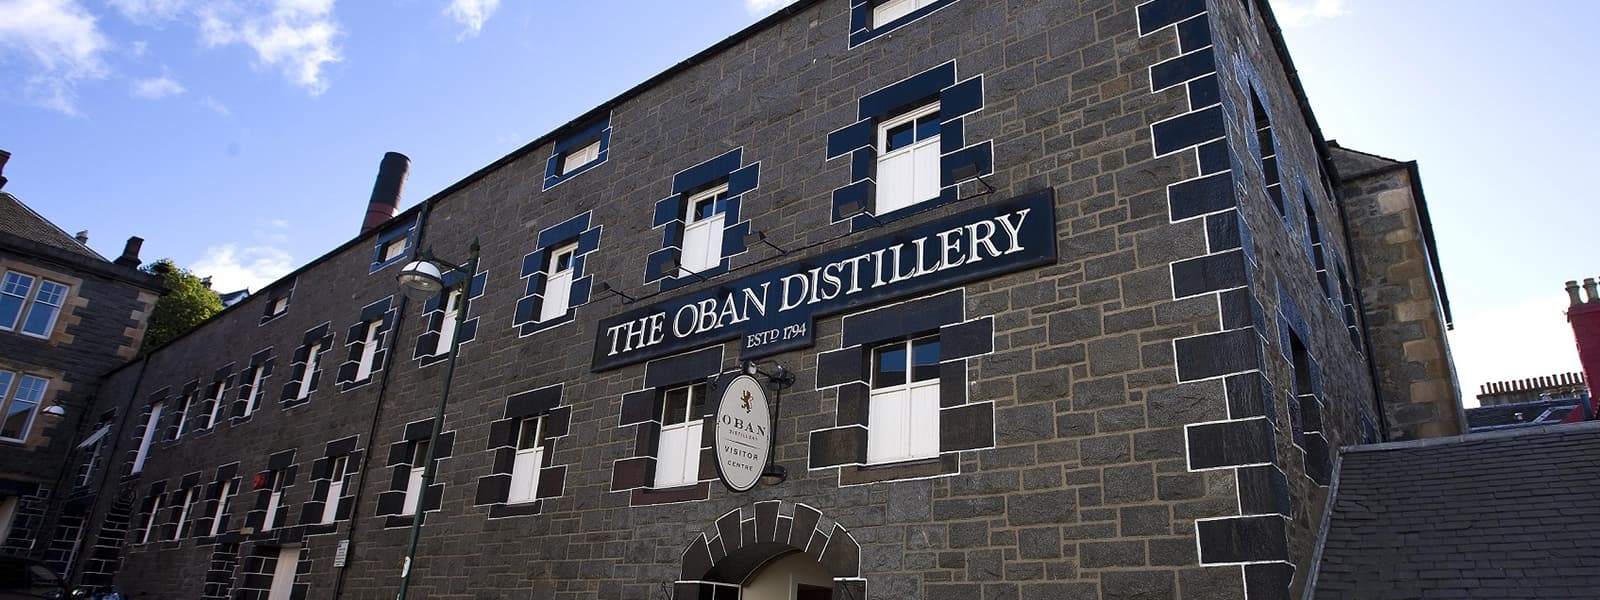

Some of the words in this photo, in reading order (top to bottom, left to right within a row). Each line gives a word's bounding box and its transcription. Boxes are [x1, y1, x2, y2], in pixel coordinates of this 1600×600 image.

[606, 311, 666, 357] THE
[672, 281, 771, 335] OBAN
[778, 208, 1031, 313] DISTILLERY
[782, 323, 807, 342] 1794
[722, 414, 765, 437] OBAN
[729, 429, 758, 441] DISTILLERY
[724, 445, 758, 461] VISITOR
[727, 460, 753, 472] CENTRE
